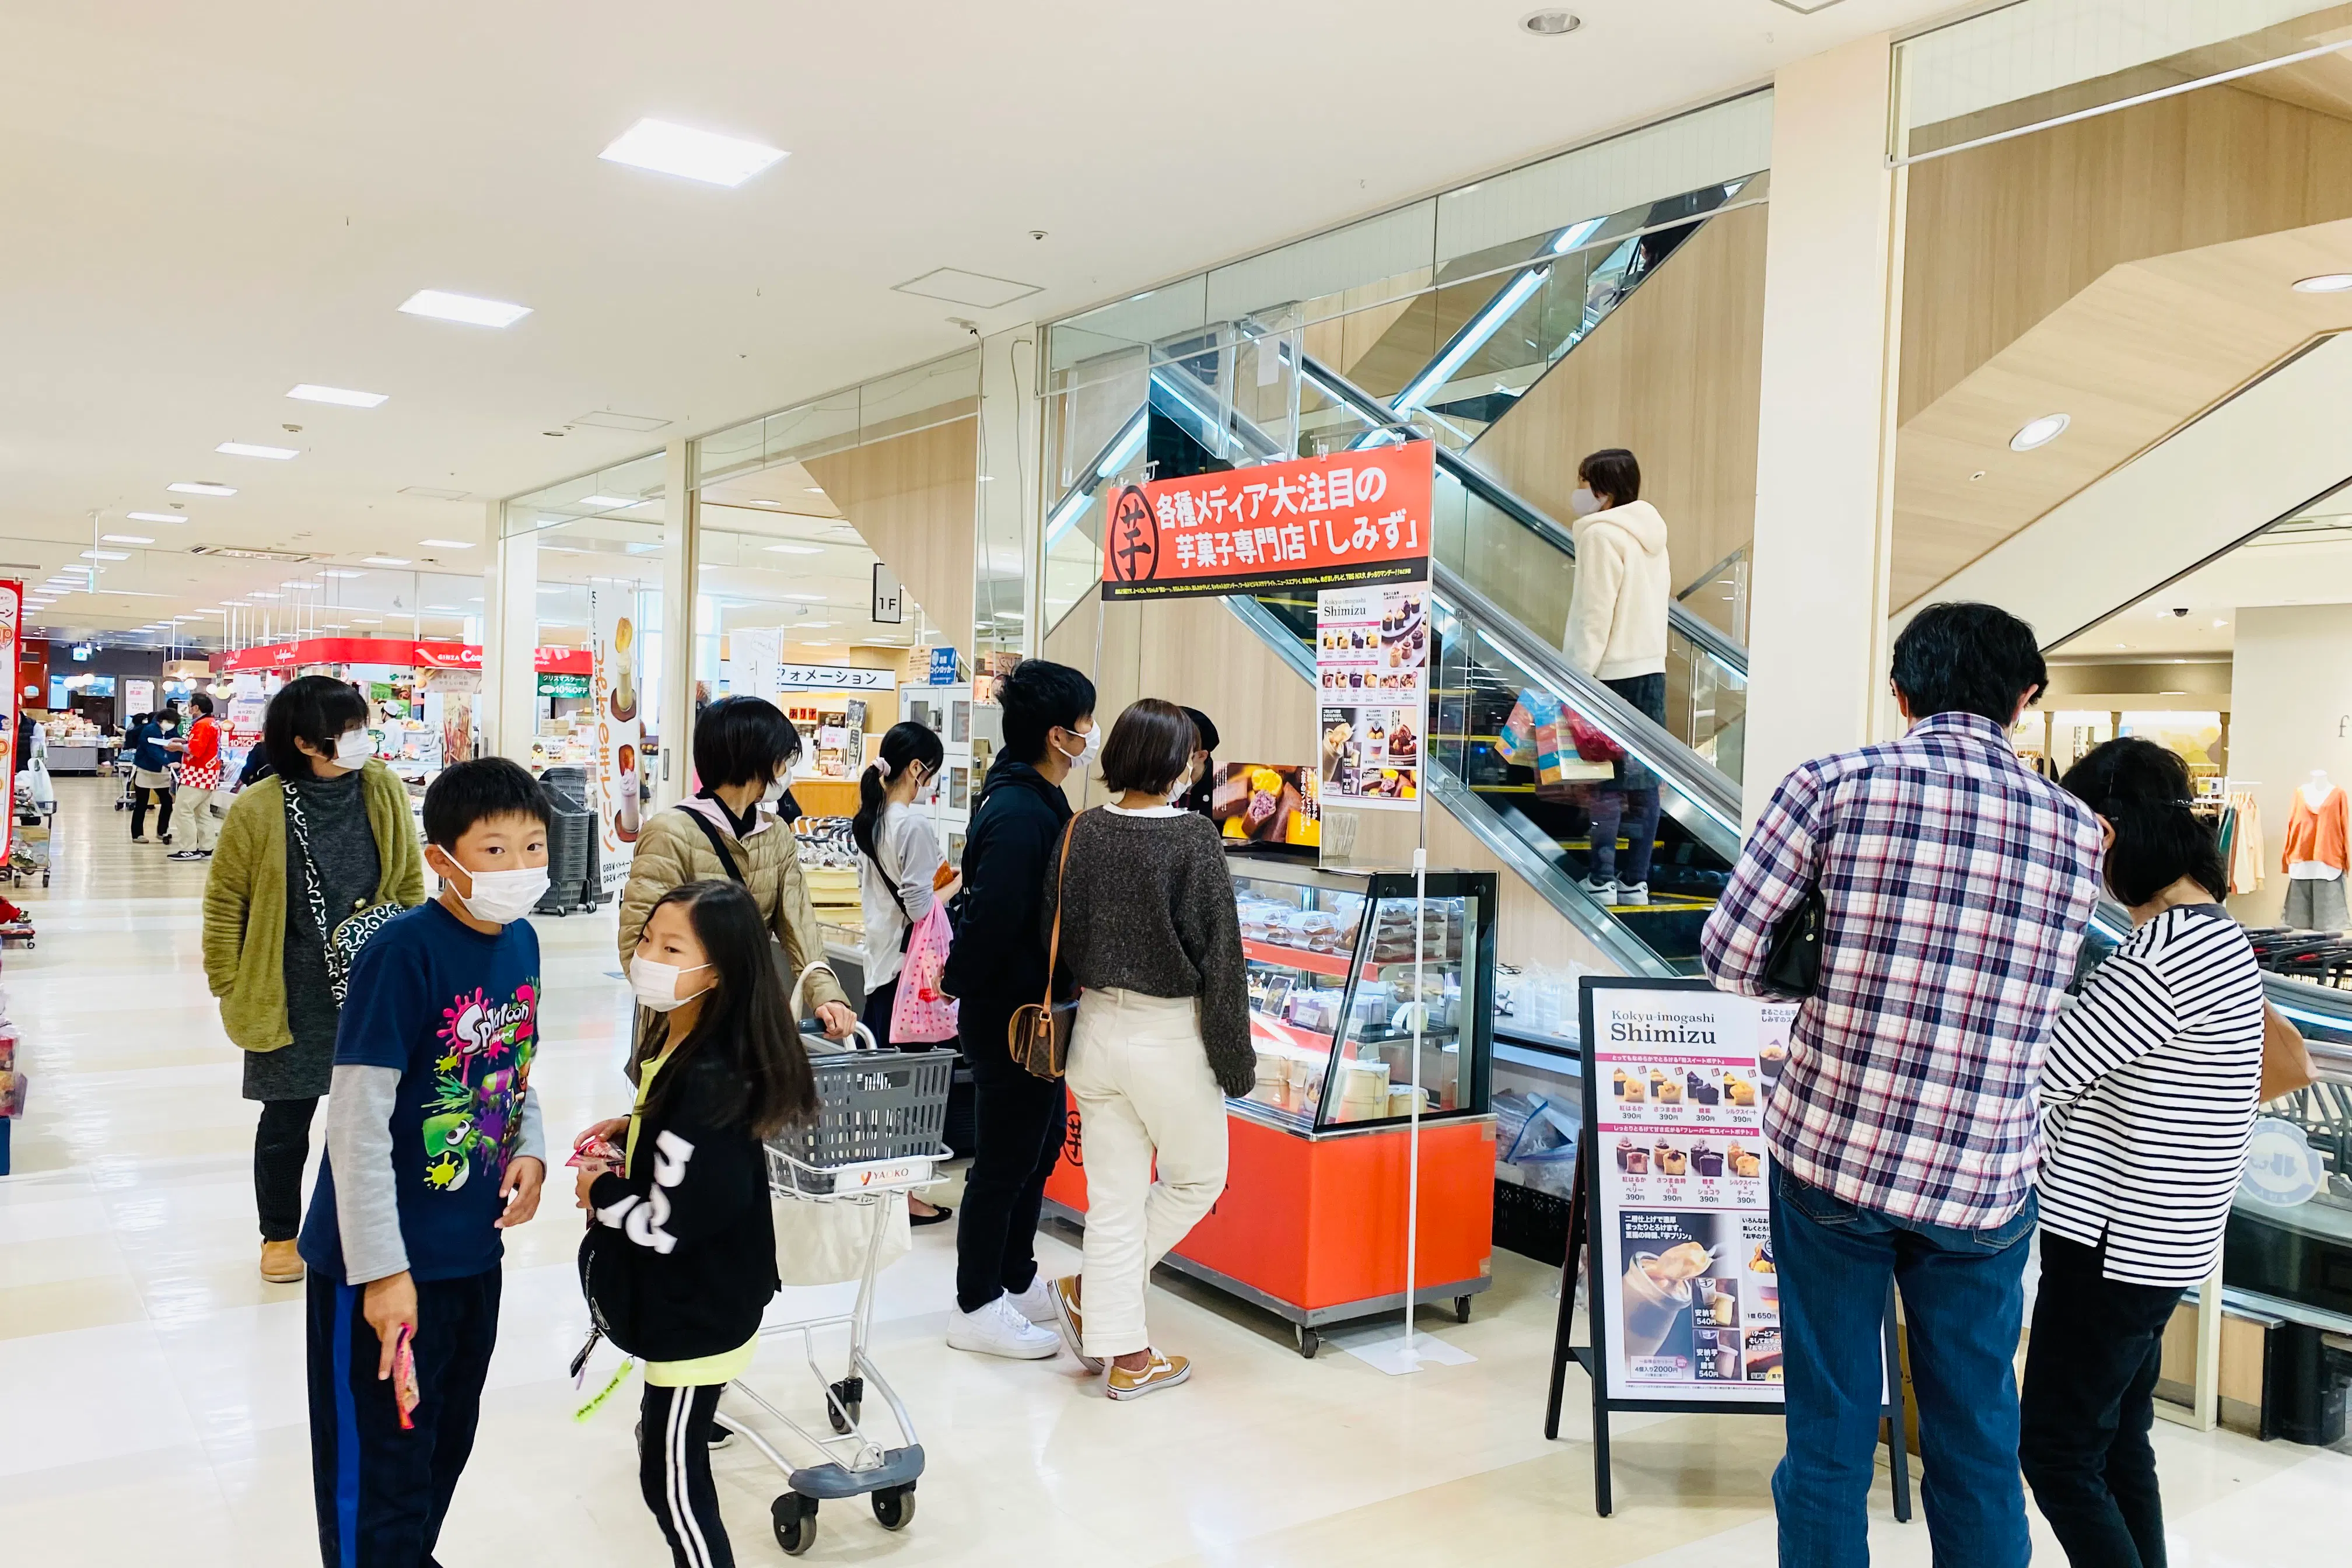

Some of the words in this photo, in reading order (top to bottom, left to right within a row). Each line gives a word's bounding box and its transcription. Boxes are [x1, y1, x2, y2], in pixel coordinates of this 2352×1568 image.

[1156, 467, 1387, 530] 各種メディア大注目の
[1117, 499, 1152, 578] 芋
[1174, 509, 1418, 569] 芋菓子専門店「しみず」
[878, 597, 896, 610] 1F
[1324, 605, 1366, 617] Shimizu
[542, 675, 587, 683] クリスマスケーキ
[555, 685, 589, 694] 10%OFF
[515, 984, 537, 1044] 2
[1612, 1010, 1715, 1024] Kokyu-imogashi
[456, 1002, 529, 1054] Splatoon
[1611, 1022, 1717, 1044] Shimizu
[874, 1168, 909, 1180] YAOKO
[1696, 1317, 1717, 1325] 540円
[1699, 1369, 1719, 1378] 540円
